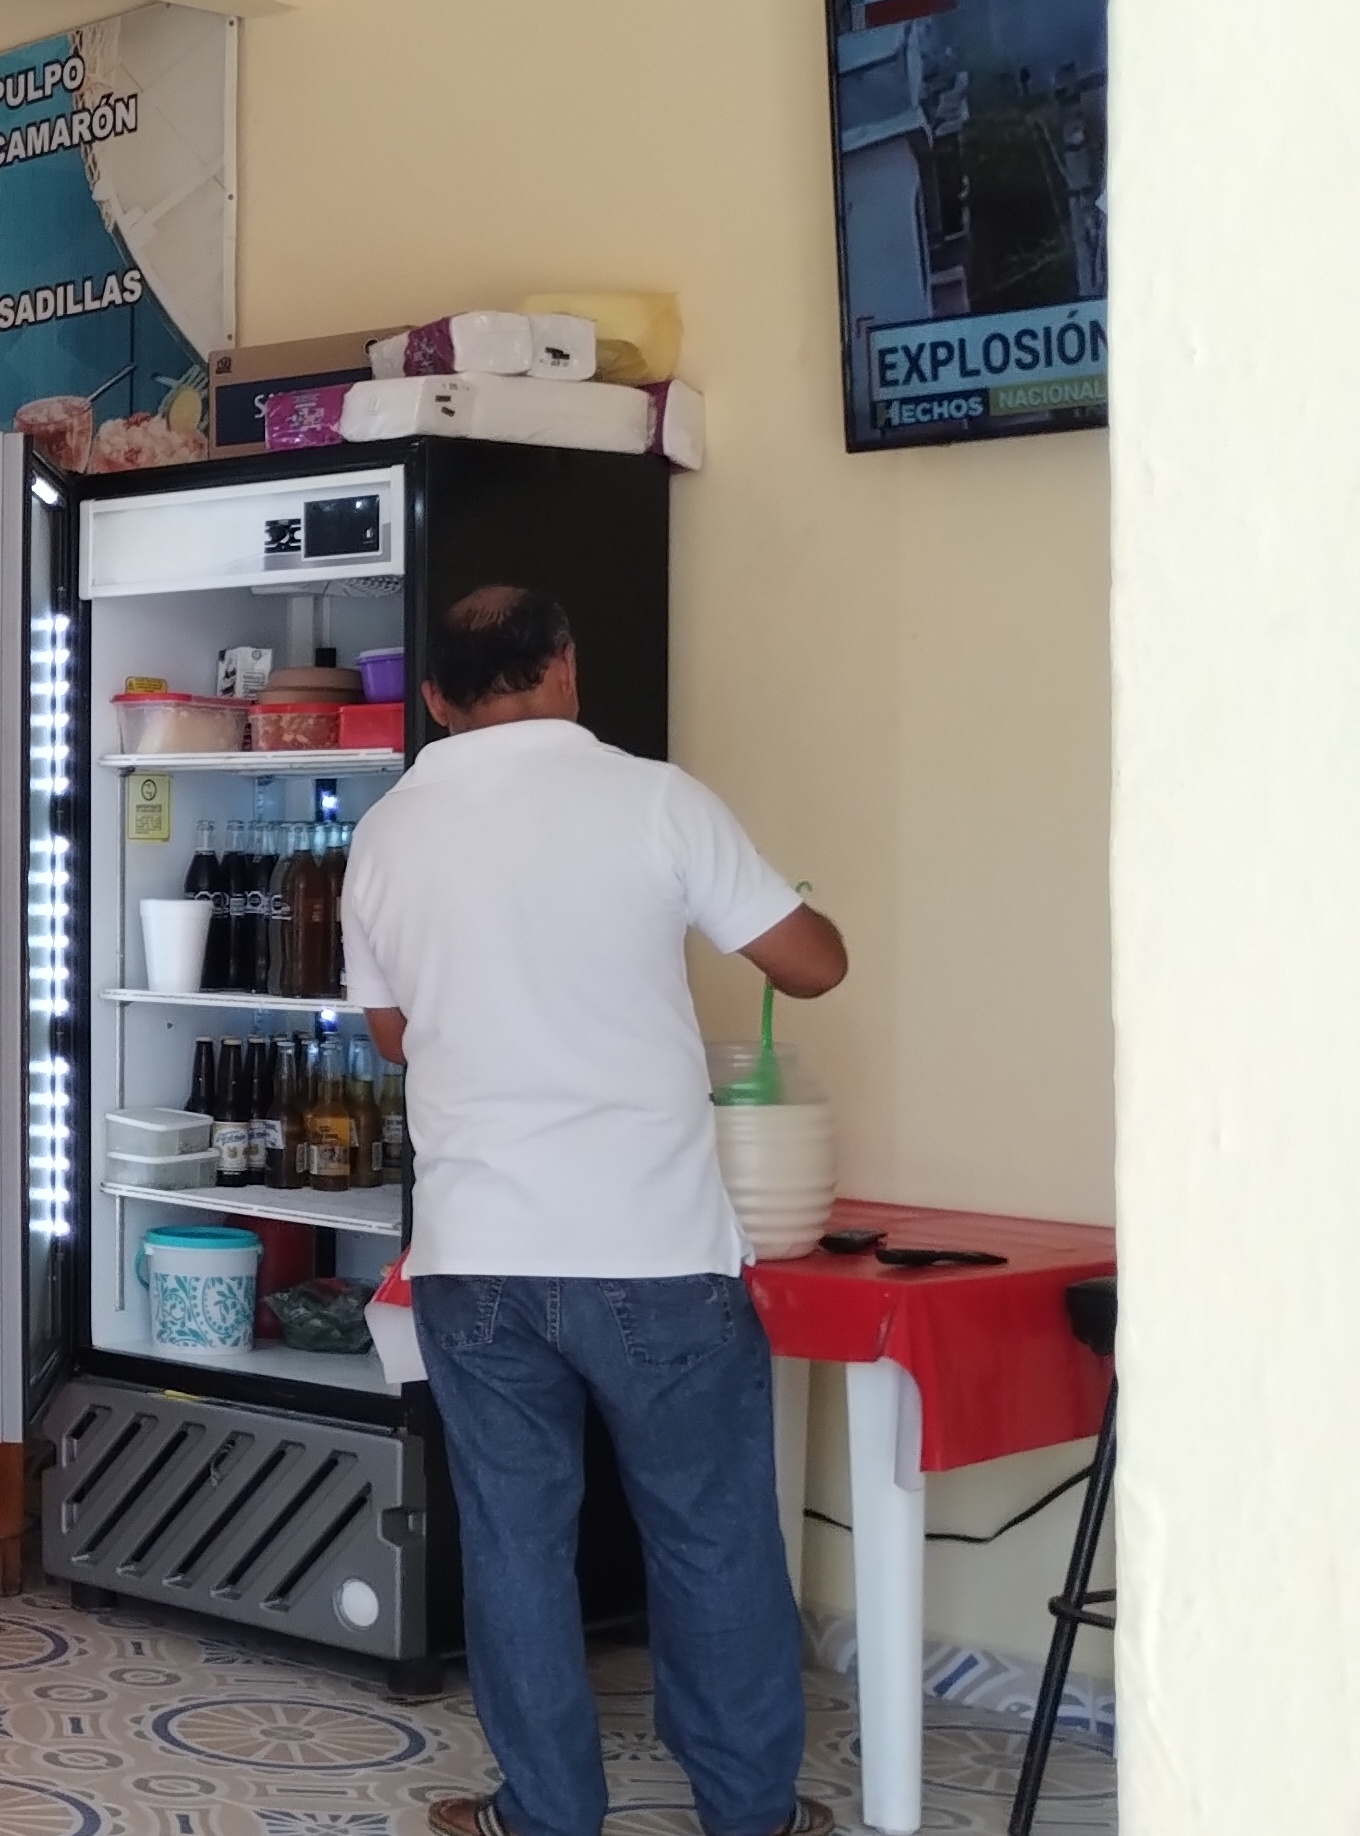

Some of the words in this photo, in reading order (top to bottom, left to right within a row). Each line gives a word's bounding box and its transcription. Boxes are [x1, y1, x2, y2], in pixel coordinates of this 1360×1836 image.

[878, 309, 1108, 388] EXPLOSIÓN
[876, 397, 984, 428] HECHOS
[998, 379, 1107, 409] NACIONAL
